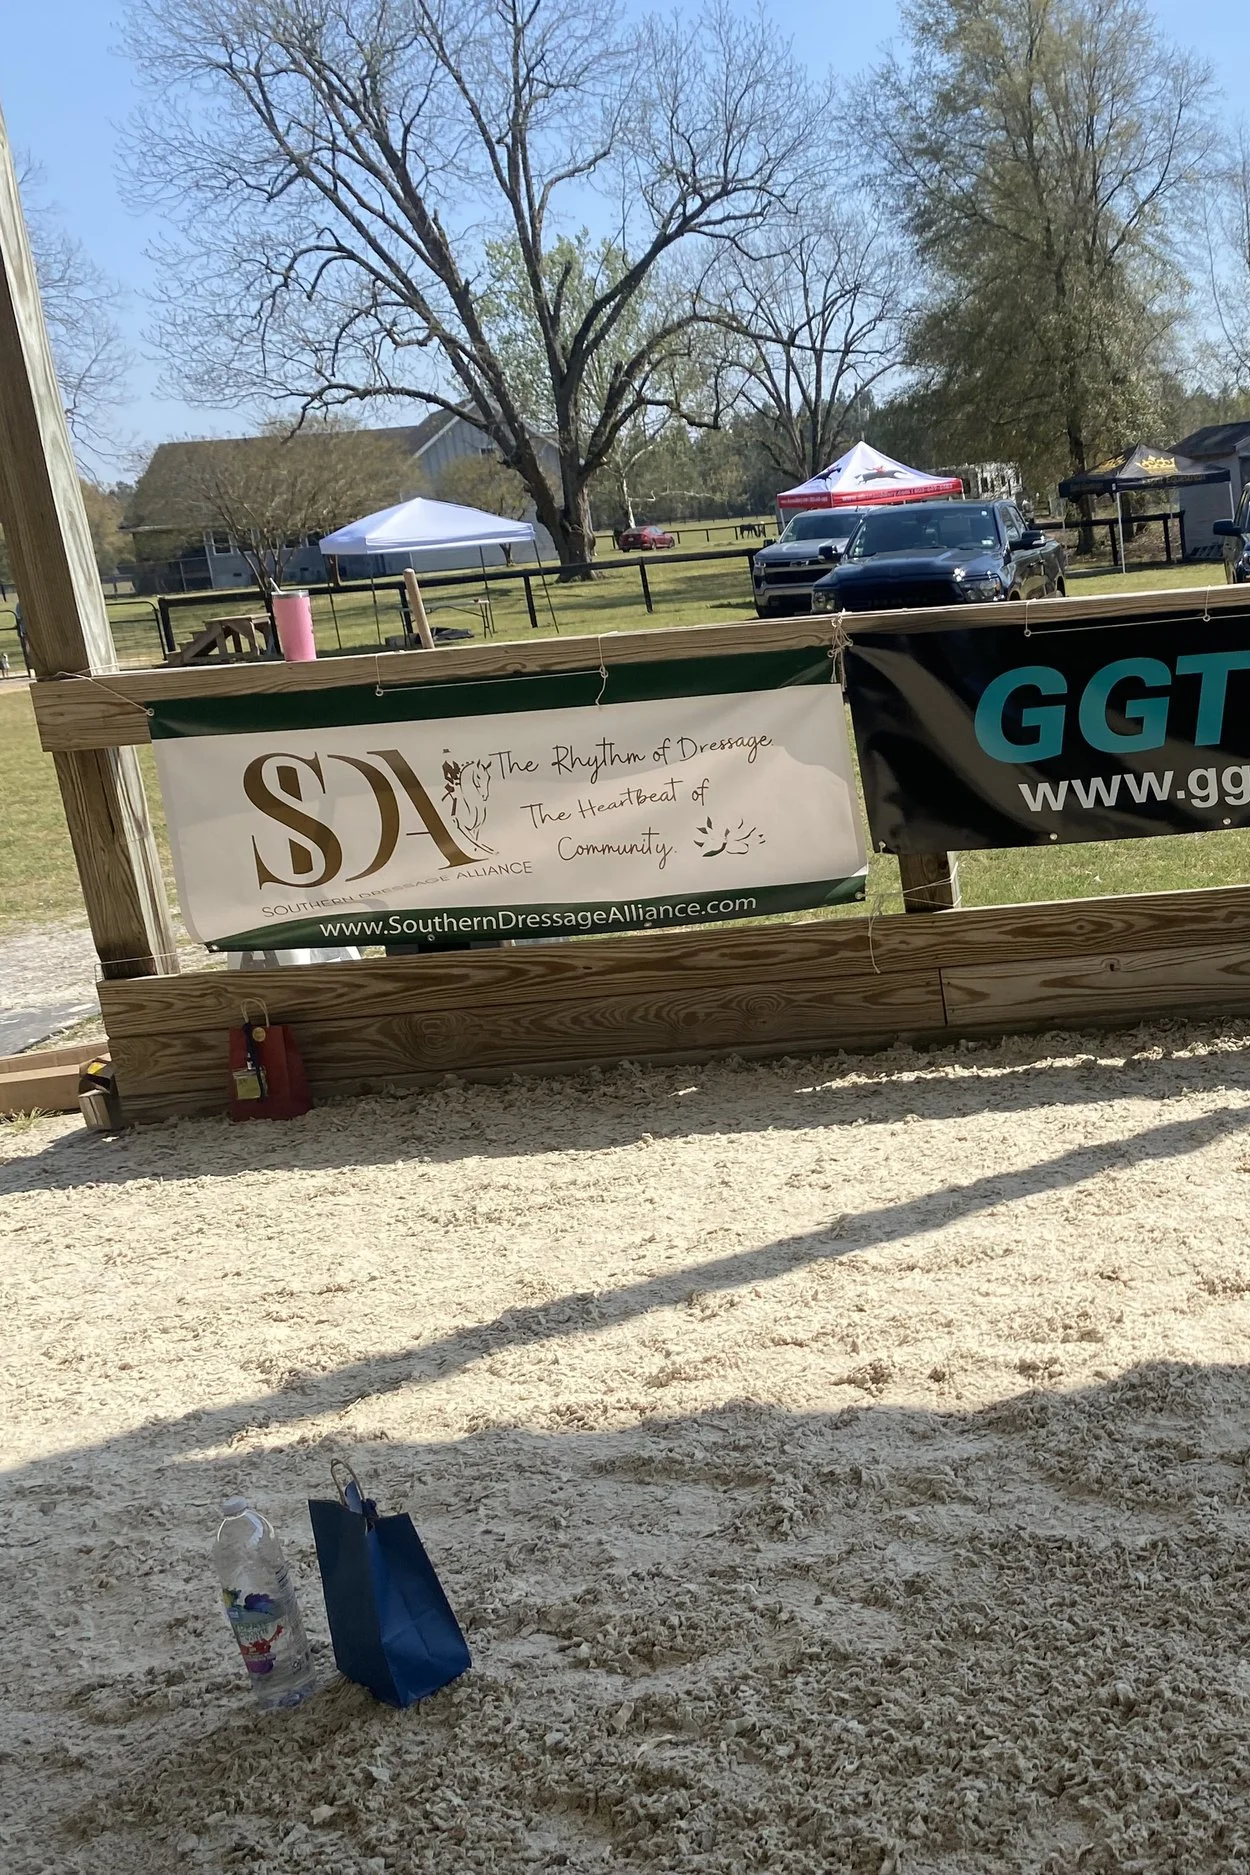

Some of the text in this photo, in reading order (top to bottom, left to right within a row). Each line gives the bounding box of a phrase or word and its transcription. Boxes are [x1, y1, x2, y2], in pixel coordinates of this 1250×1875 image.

[488, 733, 774, 784] The Rhythm of Dressage.
[520, 803, 571, 829] The
[691, 778, 710, 806] of
[557, 826, 677, 870] Community.
[261, 861, 533, 918] SOUTHERN DRESSAGE ALLIANCE
[319, 894, 758, 938] www.SouthernDressageAlliance.com
